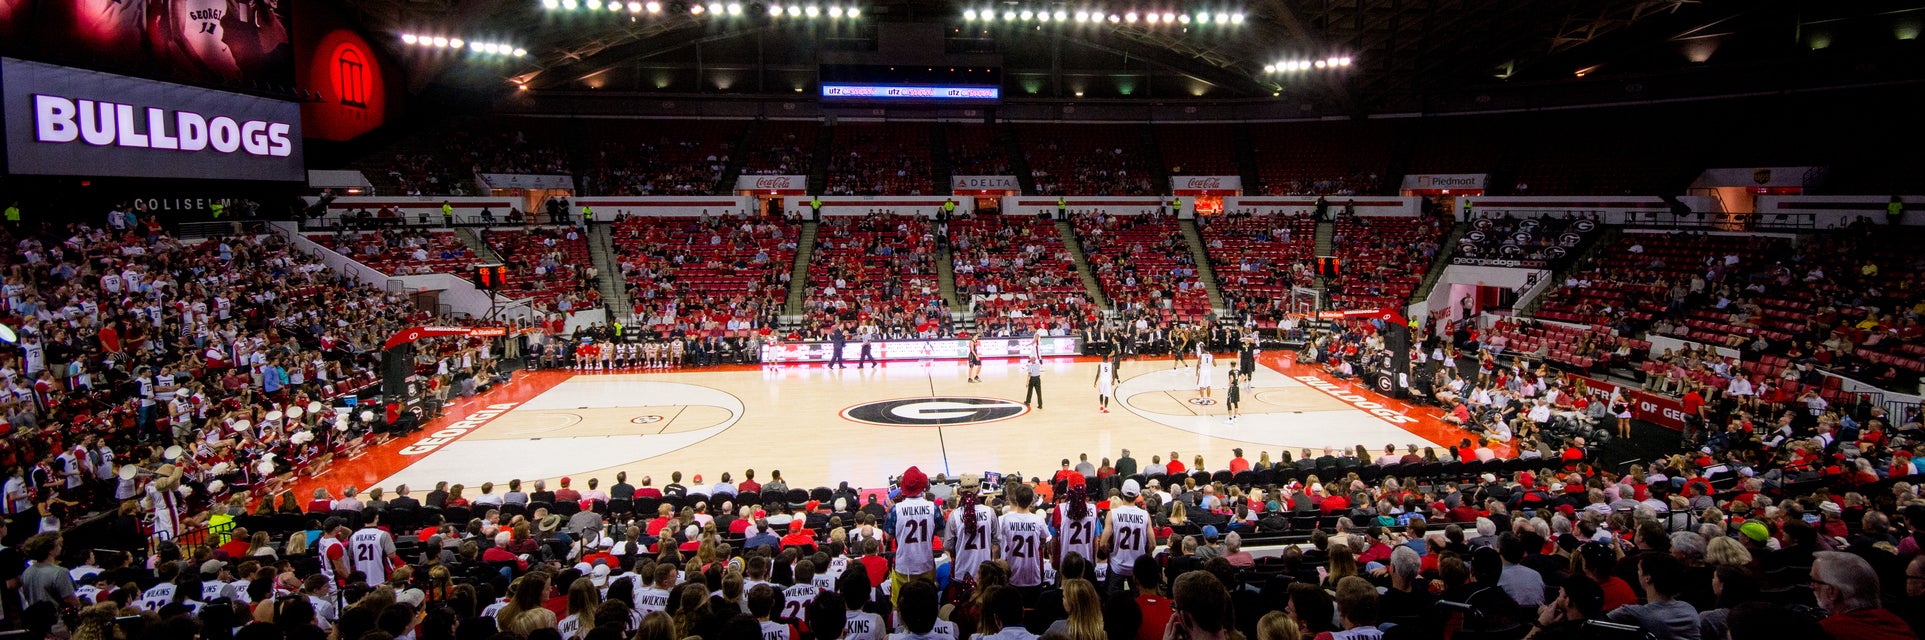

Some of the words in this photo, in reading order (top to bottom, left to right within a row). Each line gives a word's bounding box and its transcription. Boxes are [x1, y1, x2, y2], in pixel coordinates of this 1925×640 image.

[34, 94, 292, 157] BULLDOGS
[970, 179, 1010, 187] DELTA
[1432, 177, 1475, 186] Piedmont
[1453, 257, 1547, 268] georgiadogs.com
[1294, 376, 1419, 423] BULLDOGS
[1587, 386, 1611, 401] VER
[1641, 401, 1658, 413] OF
[398, 402, 519, 455] GEORGIA
[902, 506, 930, 516] WILKINS
[1117, 513, 1144, 524] WILKINS
[905, 519, 927, 544] 21
[1009, 522, 1036, 532] WILKINS
[1069, 521, 1092, 545] 21
[355, 533, 377, 542] WILKINS
[964, 525, 986, 550] 21
[1119, 526, 1141, 551] 21
[358, 543, 374, 562] 21
[1012, 534, 1034, 558] 21
[146, 587, 170, 598] WILKINS
[785, 587, 814, 598] WILKINS
[848, 620, 870, 634] KINS
